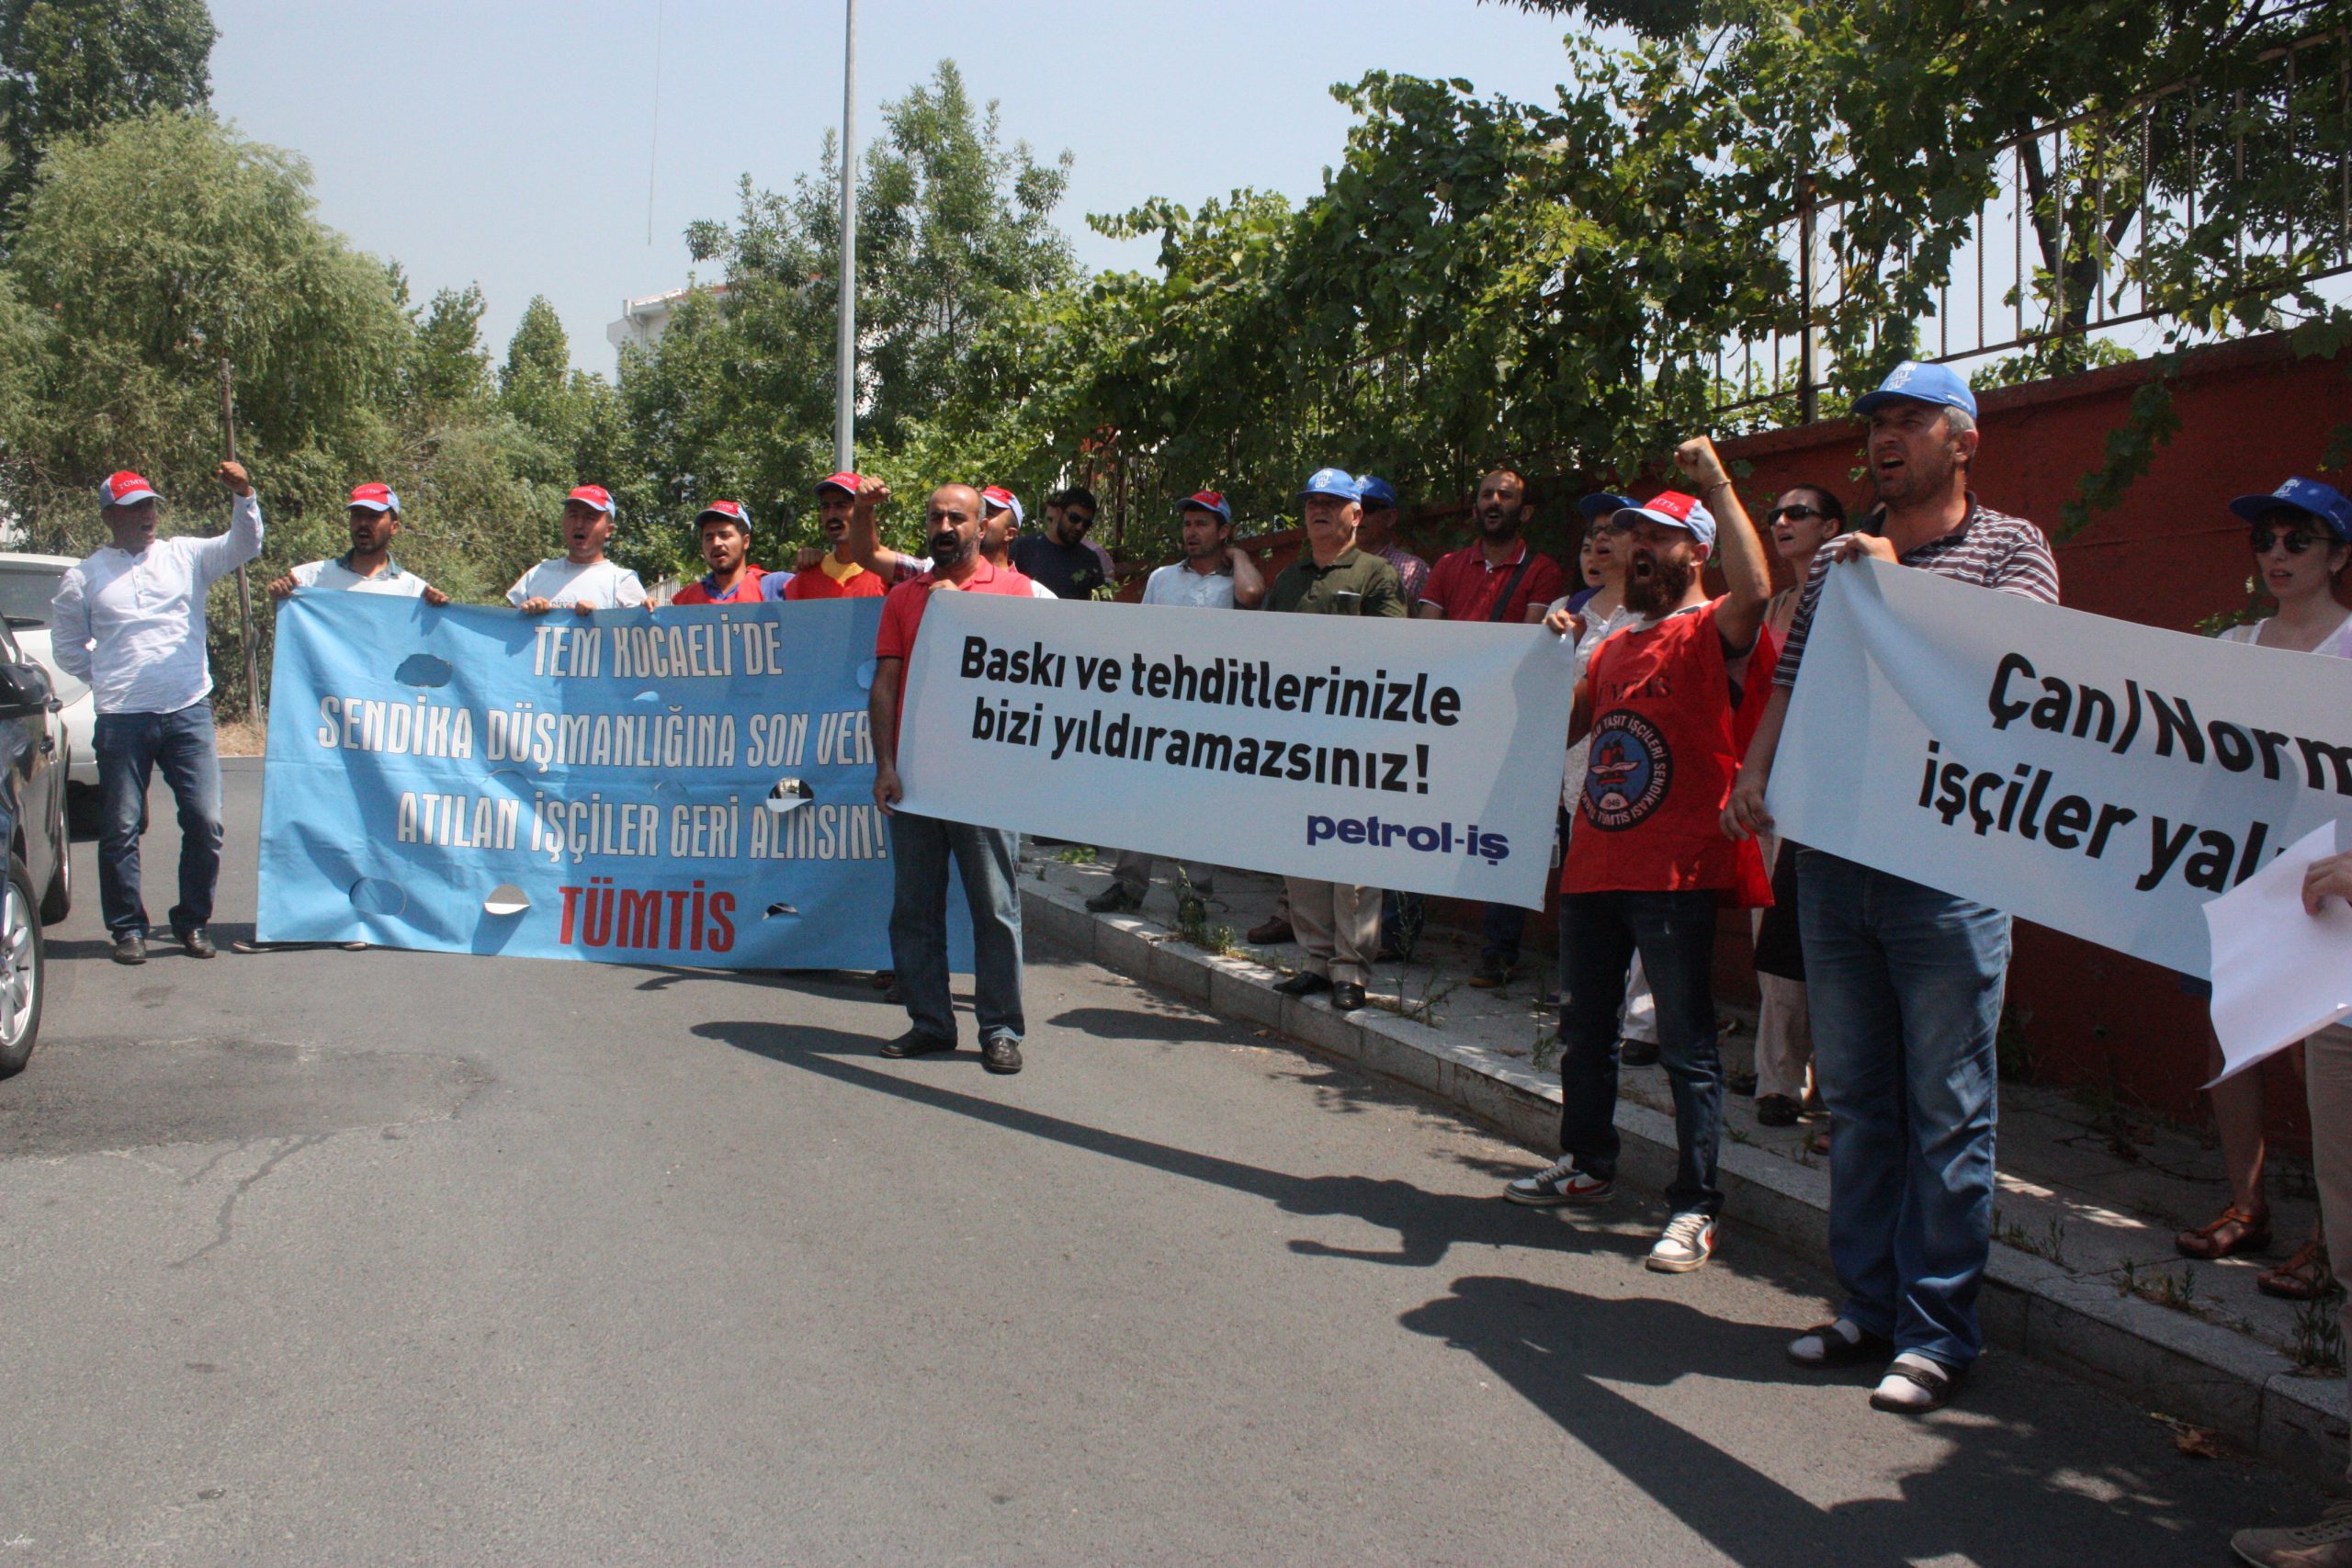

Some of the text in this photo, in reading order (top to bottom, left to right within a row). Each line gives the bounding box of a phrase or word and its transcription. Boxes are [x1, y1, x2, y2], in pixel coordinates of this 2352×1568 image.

[533, 614, 784, 678] TEM KOCAELİ'DE
[960, 636, 1462, 727] Baskı ve tehditlerinizle
[318, 696, 874, 773] SENDİKA DÜŞMANLIĞINA SON VER
[971, 696, 1430, 795] bizi yıldıramazsınız!
[398, 791, 888, 864] ATILAN İŞÇİLER GERİ ALINSIN!
[1306, 815, 1510, 866] petrol-iş
[1918, 740, 2287, 895] işçiler yal
[558, 876, 736, 953] TÜMTİS
